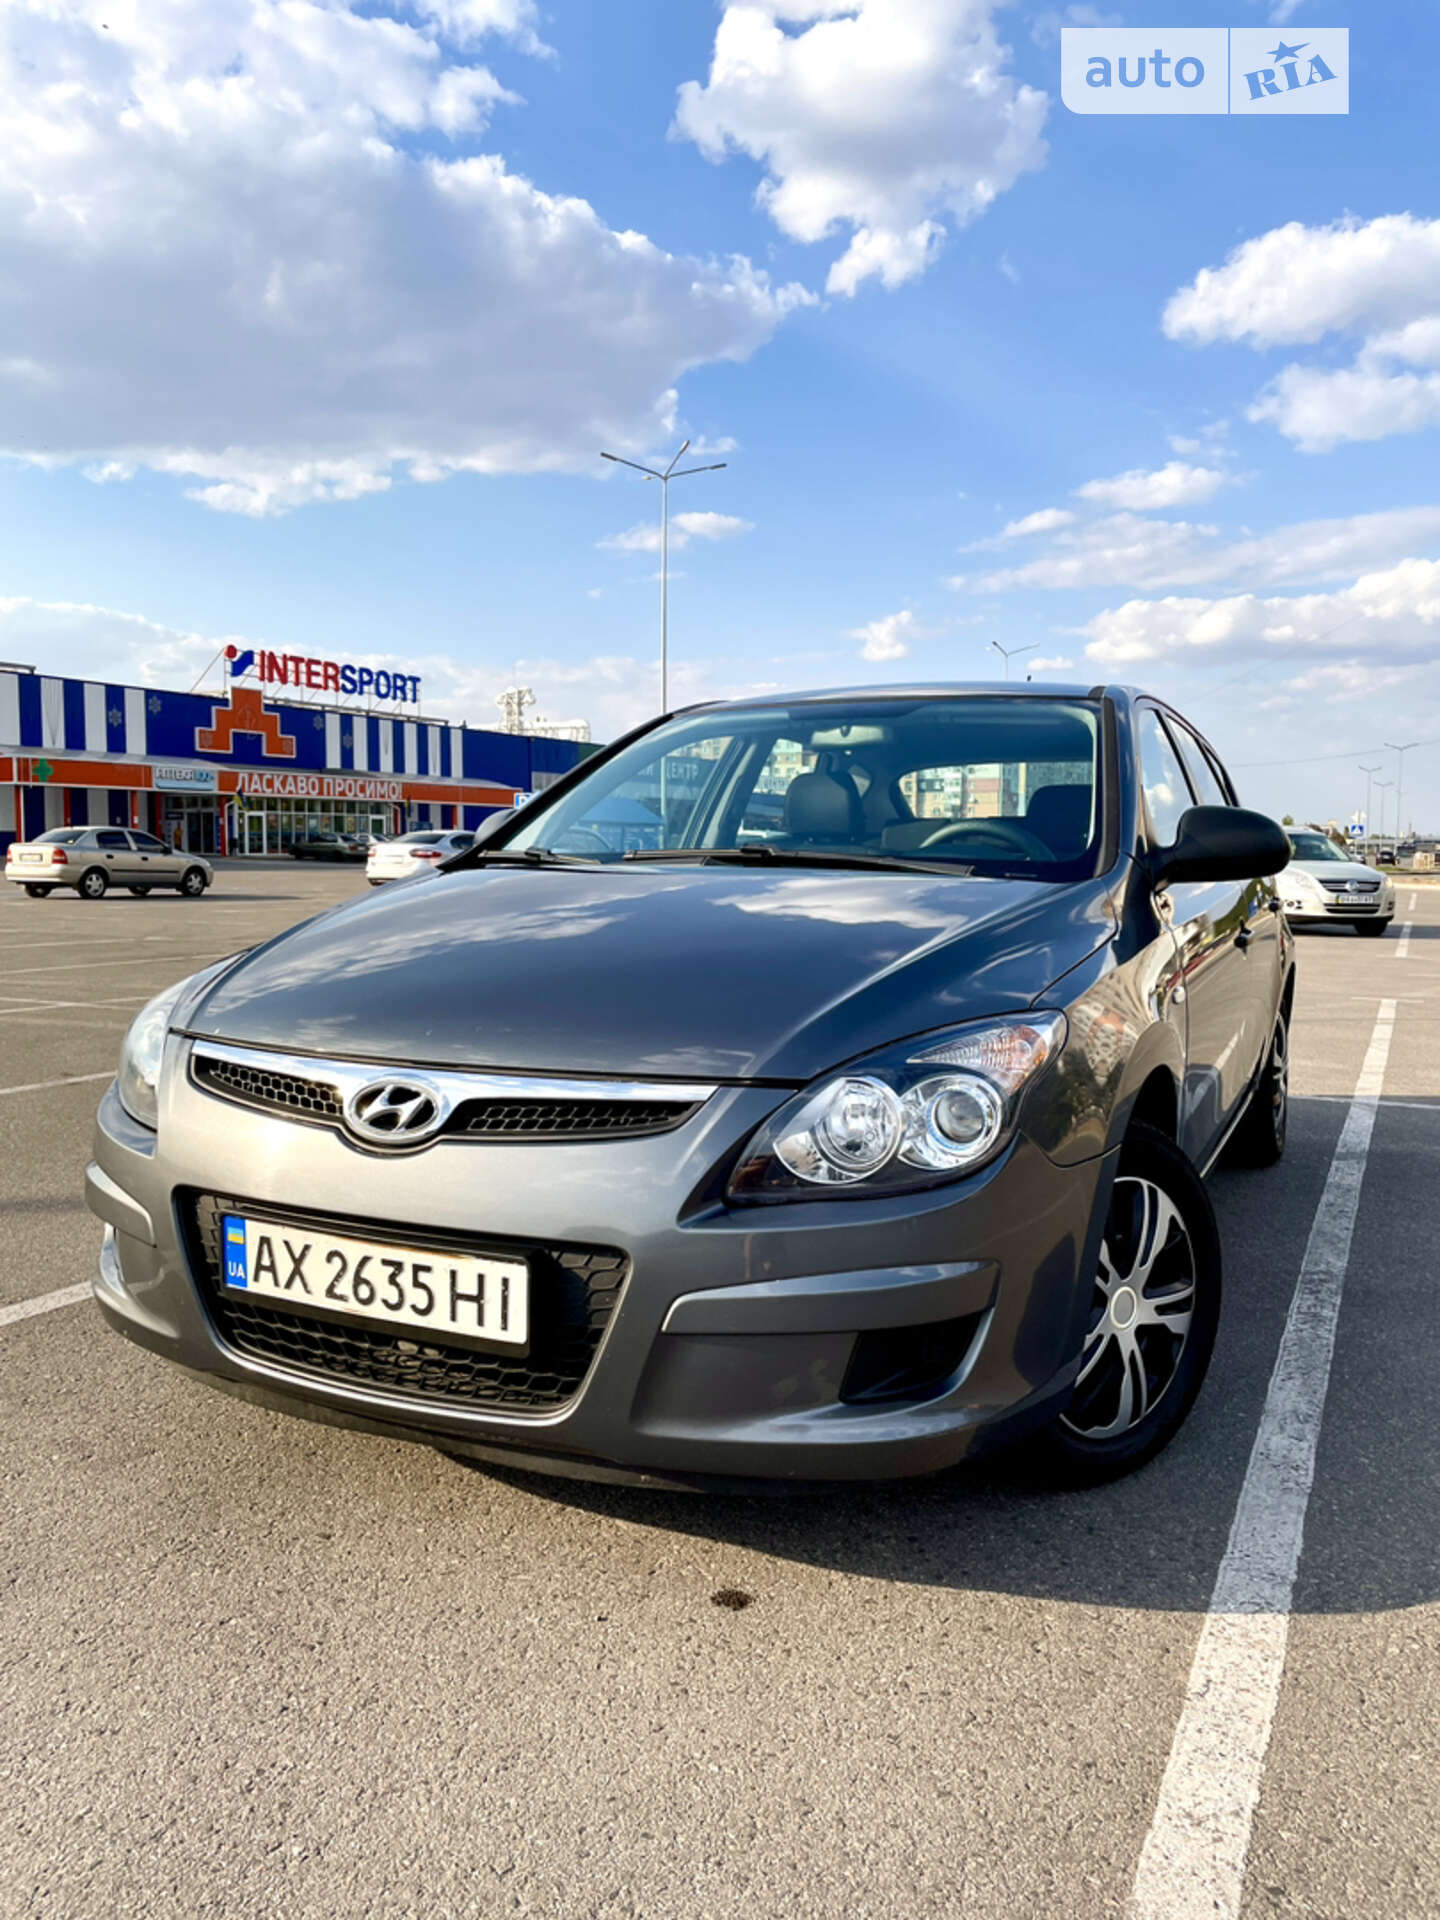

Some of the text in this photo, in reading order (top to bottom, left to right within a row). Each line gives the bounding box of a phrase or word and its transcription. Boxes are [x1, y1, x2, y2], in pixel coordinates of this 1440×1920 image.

[258, 649, 421, 703] INTERSPORT
[236, 773, 319, 795] ЛАСКАВО
[228, 1260, 246, 1279] UA
[252, 1235, 509, 1331] AX 2635 HI
